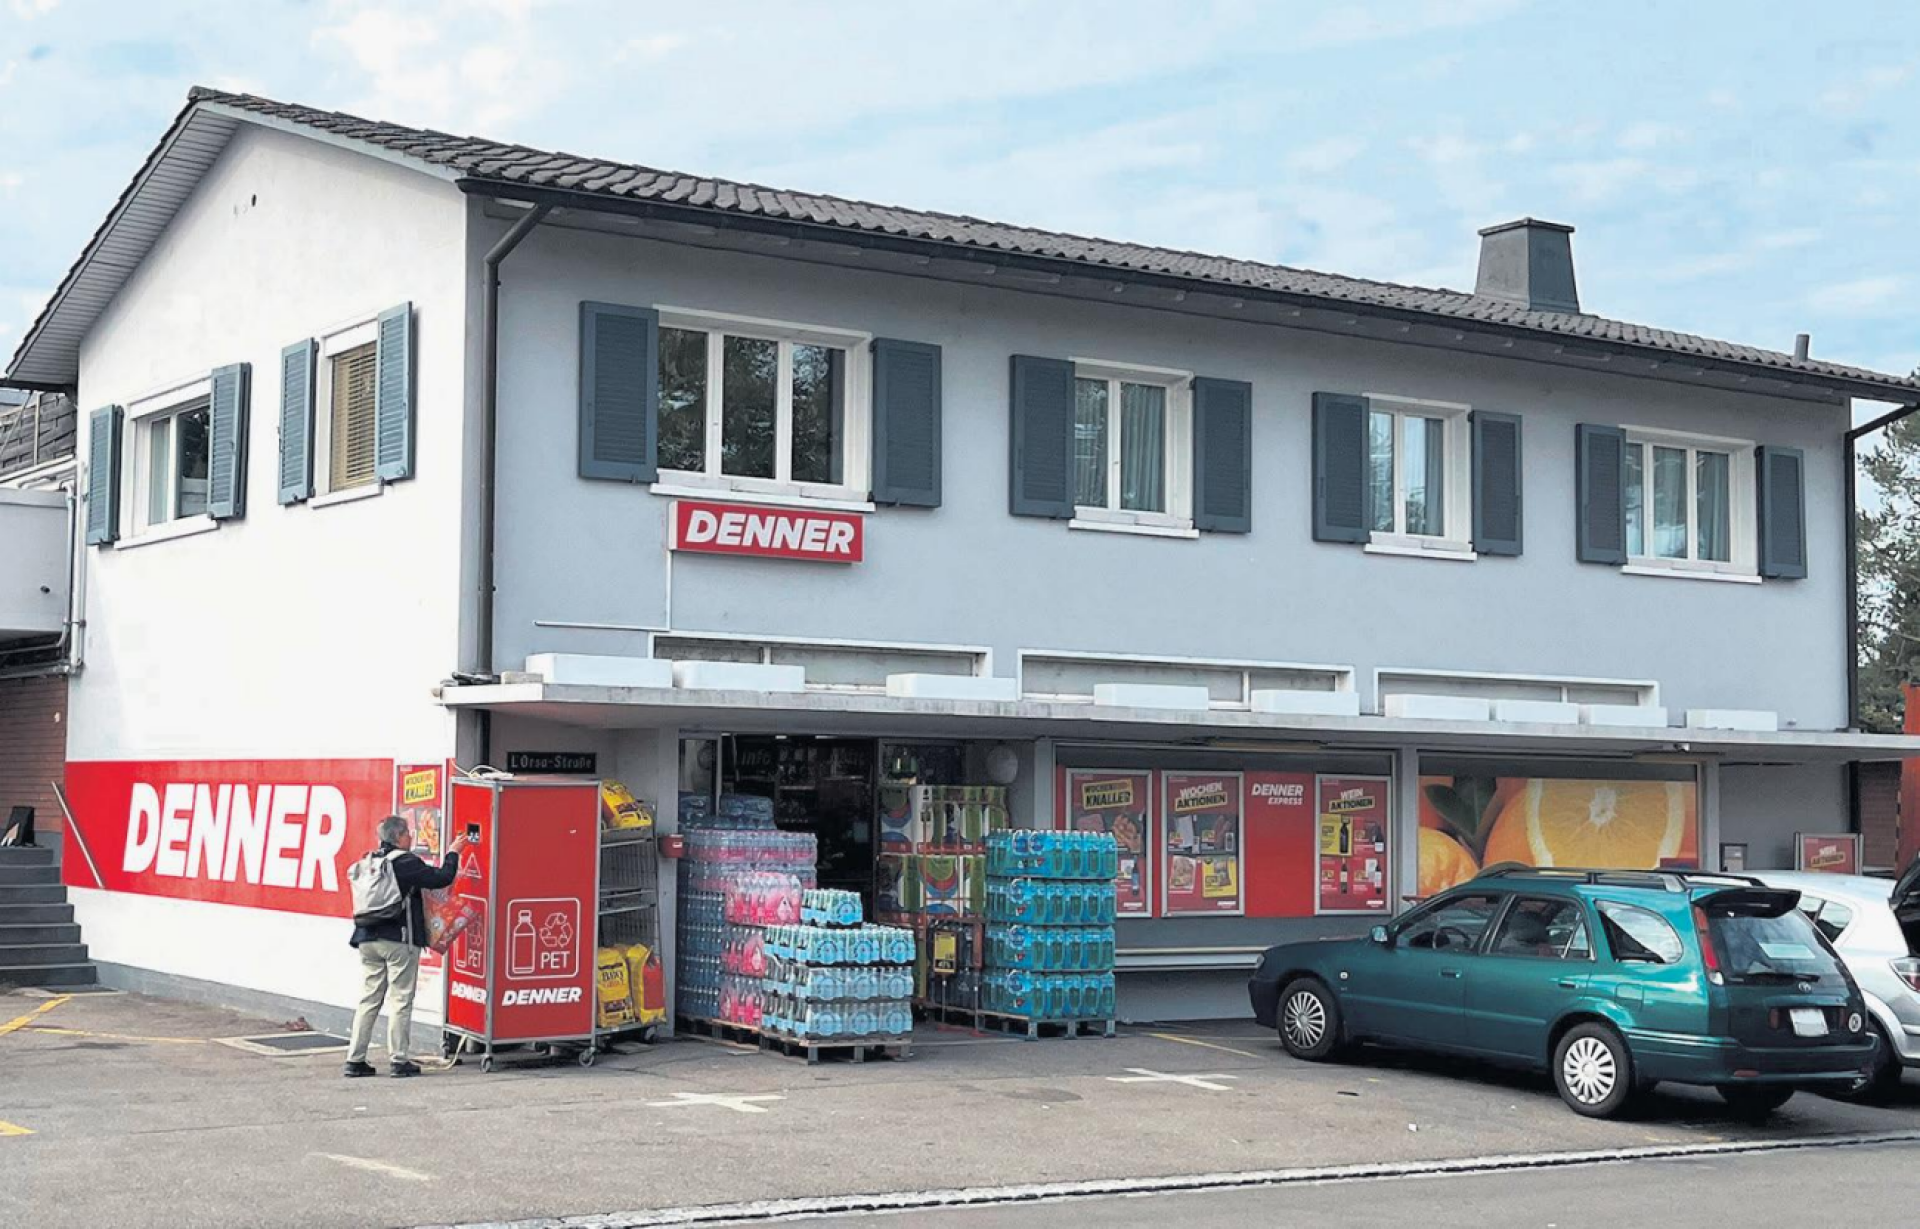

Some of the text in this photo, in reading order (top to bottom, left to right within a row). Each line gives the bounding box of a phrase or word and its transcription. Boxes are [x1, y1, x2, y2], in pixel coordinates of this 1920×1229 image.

[685, 510, 855, 554] DENNER
[1180, 782, 1222, 800] WOCHEN
[1251, 783, 1304, 796] DENNER
[1177, 793, 1226, 808] AKTIONEN
[1267, 797, 1303, 805] EXPRESS
[122, 782, 348, 892] DENNER
[540, 951, 570, 969] PET
[451, 980, 487, 1004] DENNER
[502, 987, 582, 1006] DENNER
